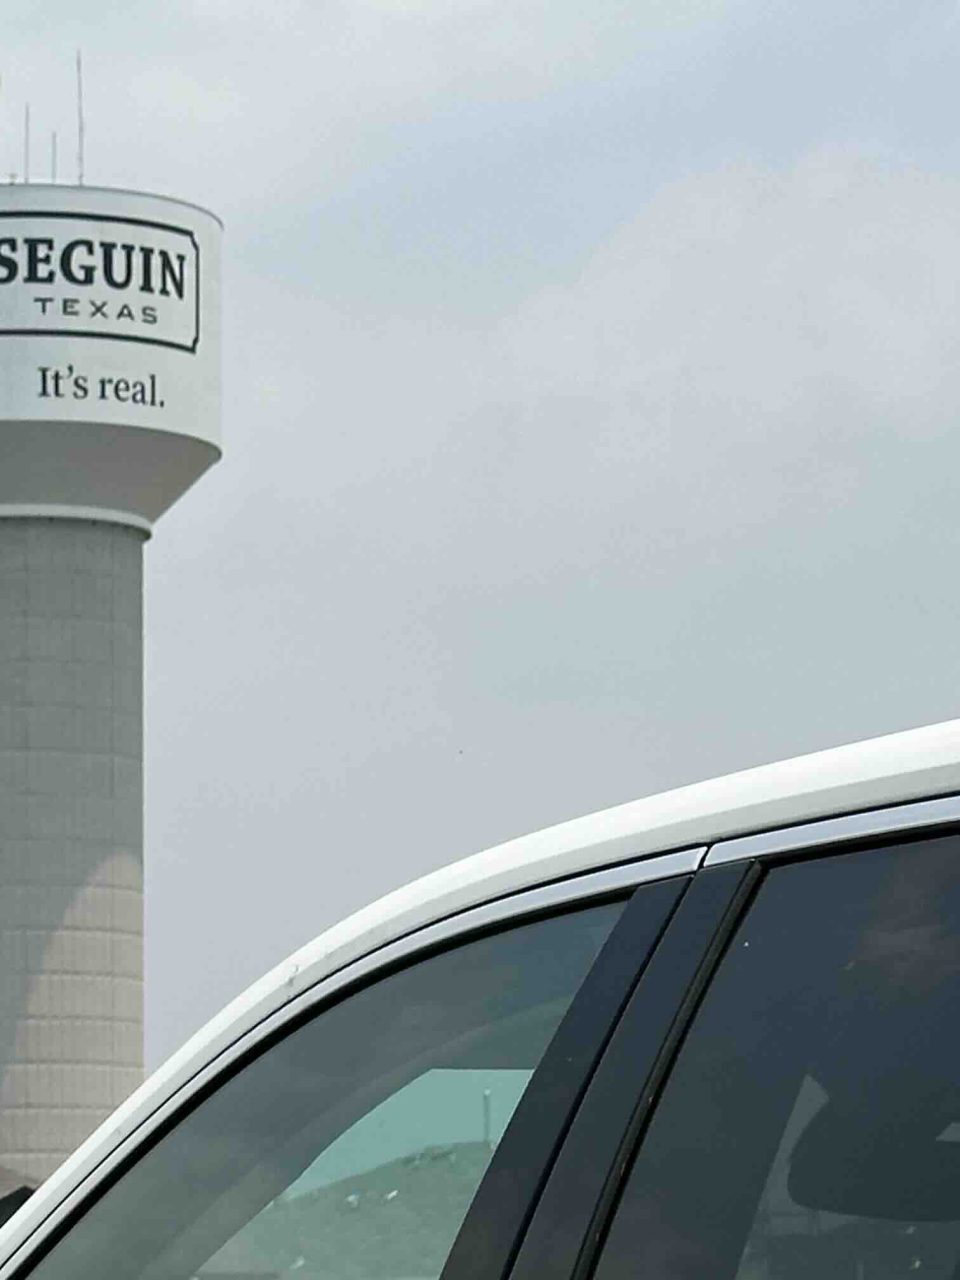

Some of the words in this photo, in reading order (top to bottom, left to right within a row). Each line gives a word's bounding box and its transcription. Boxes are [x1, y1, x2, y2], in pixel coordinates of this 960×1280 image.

[33, 297, 158, 325] TEXAS
[38, 364, 89, 400] It's
[98, 374, 165, 408] real.
